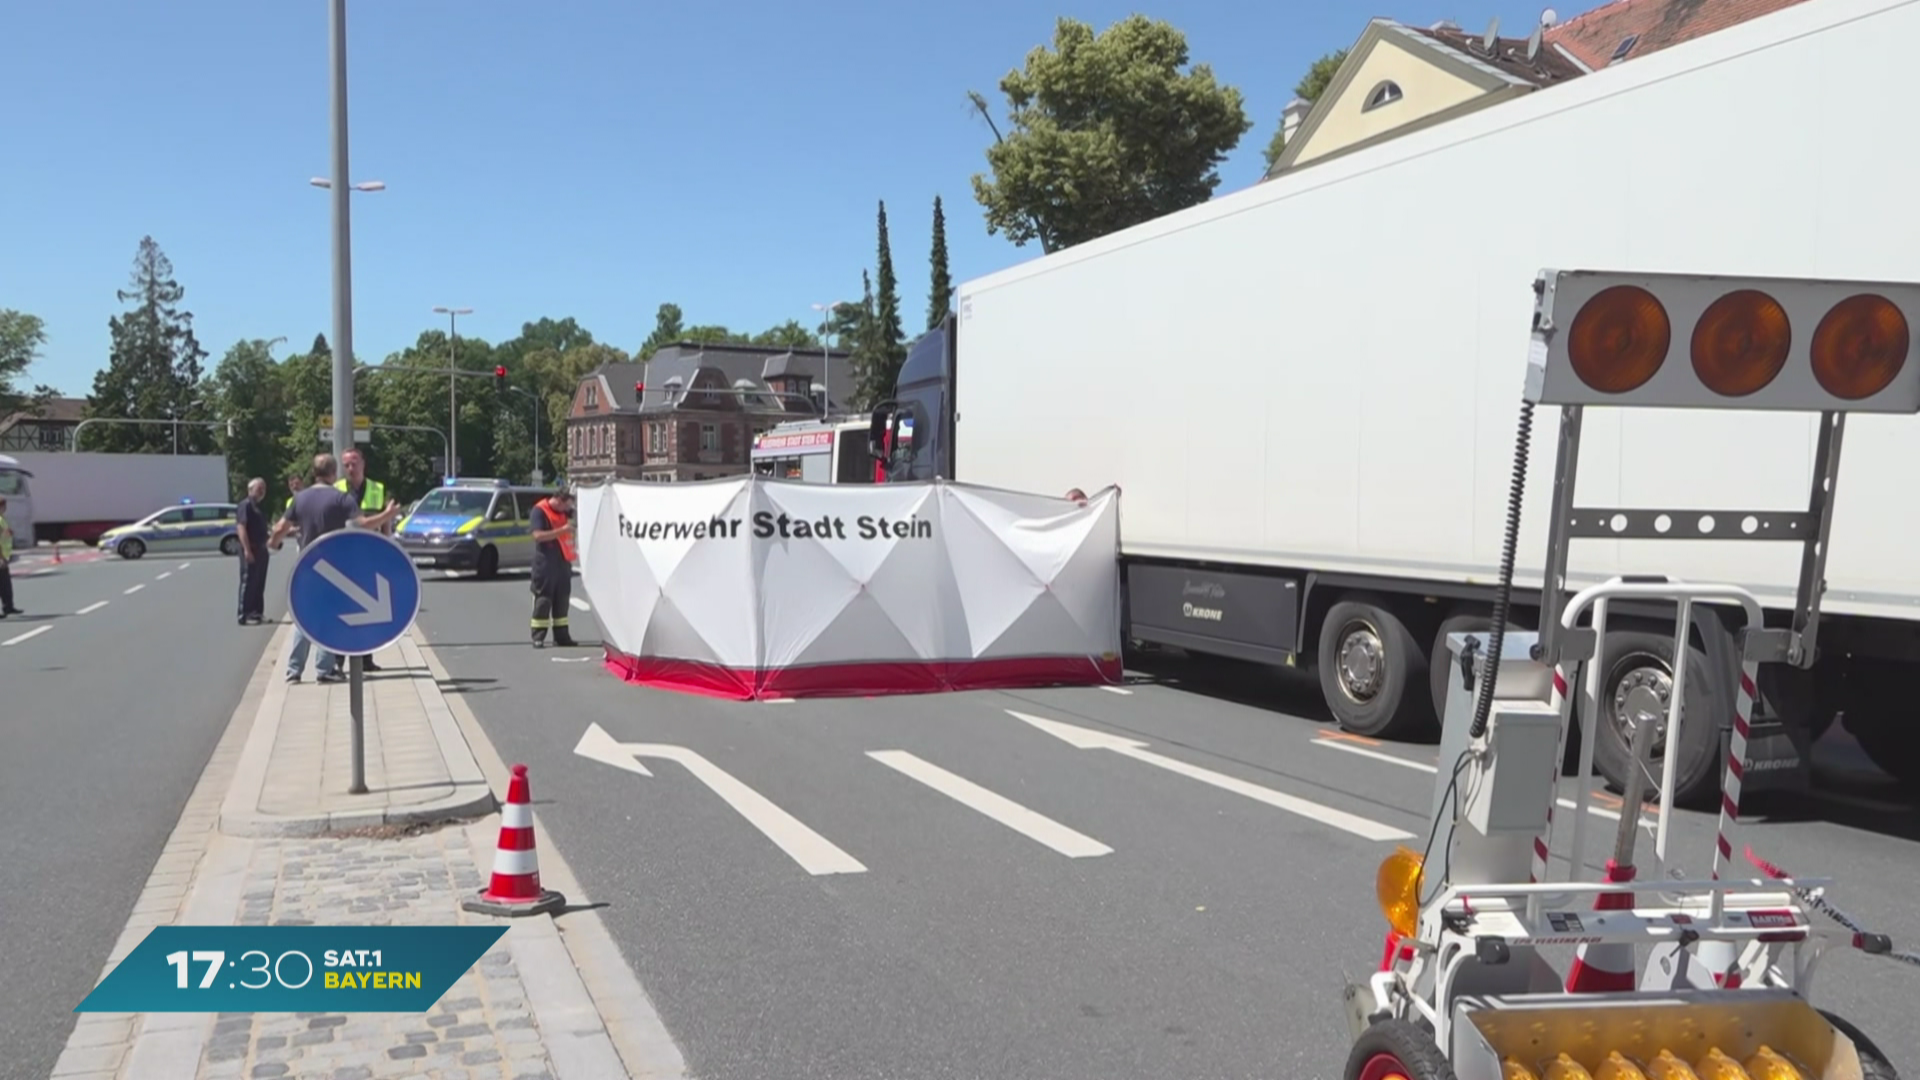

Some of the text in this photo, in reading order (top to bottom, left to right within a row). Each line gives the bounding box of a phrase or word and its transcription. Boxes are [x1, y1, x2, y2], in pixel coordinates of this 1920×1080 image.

[618, 511, 932, 541] Feuerwehr Stadt Stein
[1192, 606, 1223, 621] KRONE
[1754, 758, 1800, 771] KRONE
